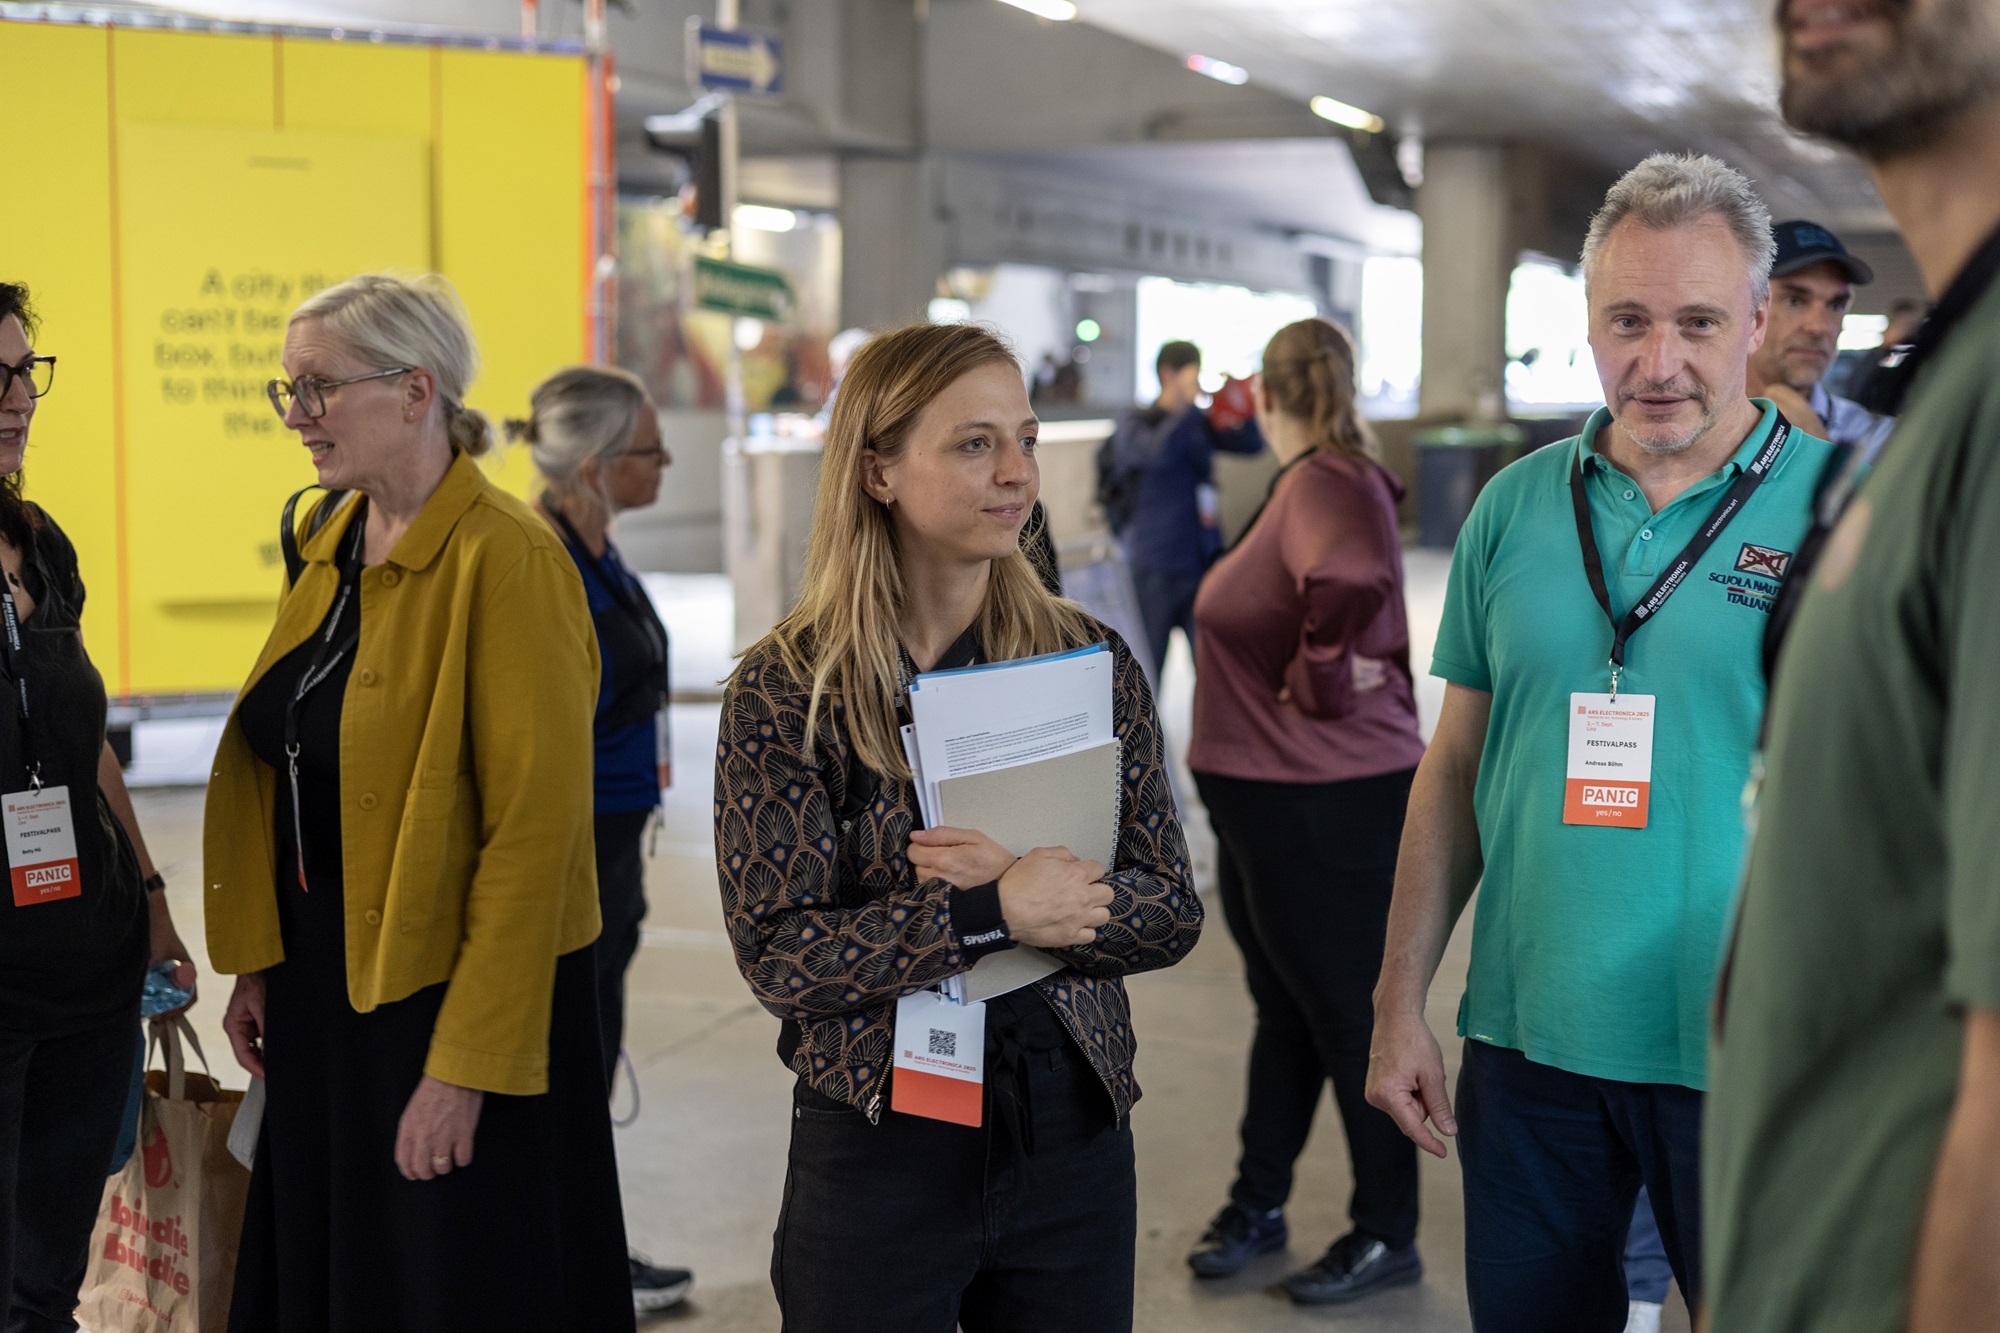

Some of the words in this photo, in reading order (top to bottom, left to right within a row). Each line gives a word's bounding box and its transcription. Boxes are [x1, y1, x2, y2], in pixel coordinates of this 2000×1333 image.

[201, 268, 225, 296] A
[231, 270, 292, 304] city
[160, 306, 237, 334] can't
[242, 306, 282, 335] be
[162, 376, 197, 405] to
[223, 411, 275, 438] the
[1760, 454, 1770, 466] ARS
[1766, 424, 1786, 456] ELECTRONICA
[1706, 498, 1738, 538] ars.electronica.art
[1647, 596, 1660, 610] ARS
[1656, 560, 1689, 599] ELECTRONICA
[1657, 586, 1675, 606] Technology
[1708, 572, 1752, 589] SCUOLA
[1752, 580, 1780, 596] NAUT
[1728, 592, 1773, 614] ITALIAN
[1587, 740, 1637, 748] FESTIVALPASS
[1584, 788, 1637, 804] PANIC
[20, 827, 61, 838] FESTIVALPASS
[27, 867, 70, 885] PANIC
[926, 1057, 962, 1068] ELECTRONICA
[110, 1196, 188, 1257] birdie
[104, 1232, 190, 1296] birdie
